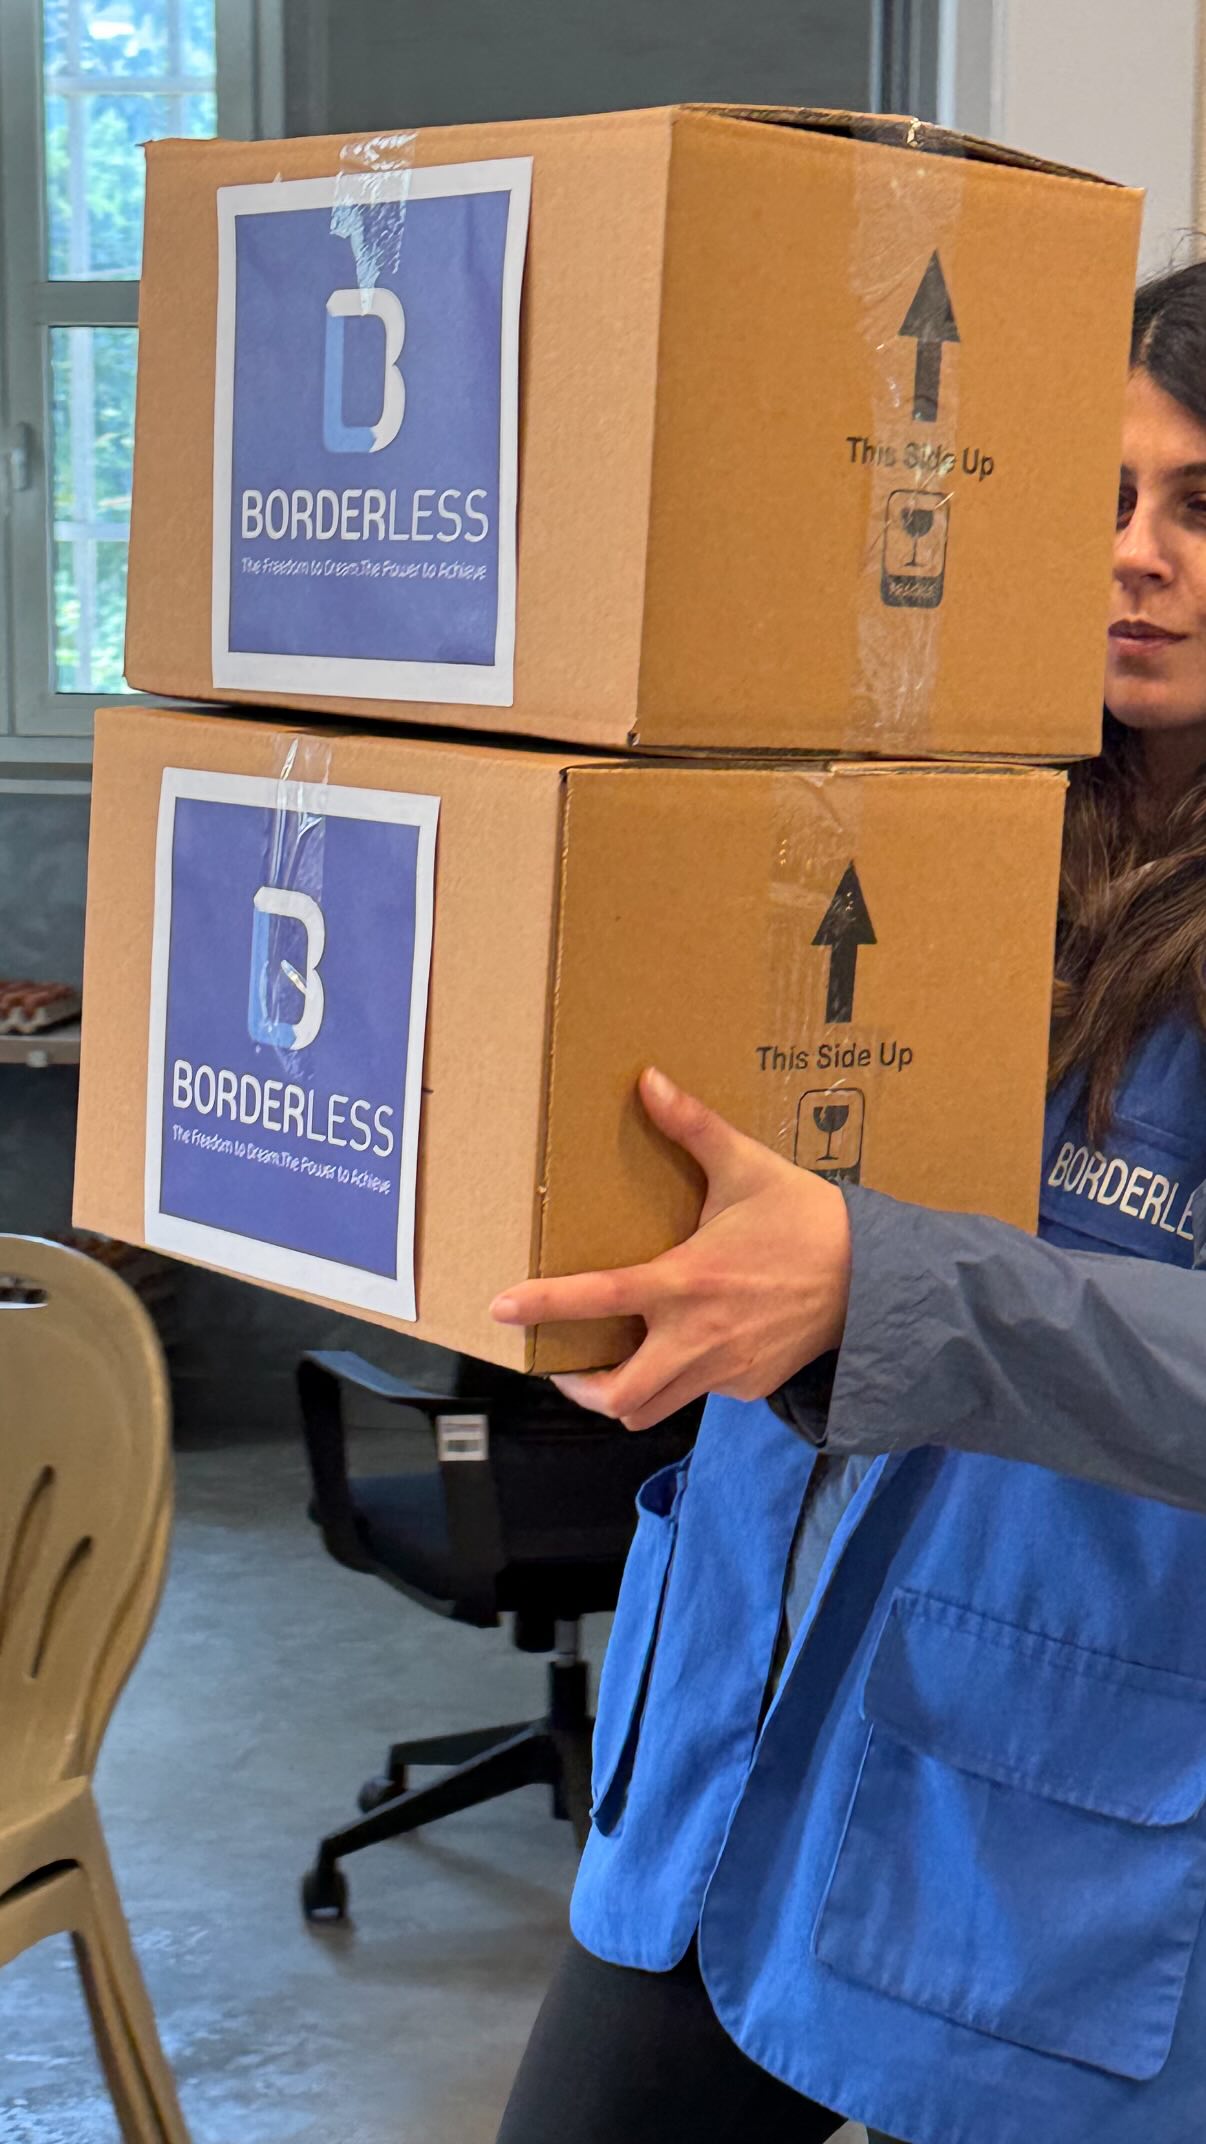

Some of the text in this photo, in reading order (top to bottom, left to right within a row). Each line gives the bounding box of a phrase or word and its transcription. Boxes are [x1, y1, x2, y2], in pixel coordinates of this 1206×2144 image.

[846, 436, 995, 482] This Side Up
[241, 487, 489, 544] BORDERLESS
[756, 1040, 913, 1072] This Side Up
[172, 1059, 395, 1158] BORDERLESS
[1047, 1141, 1195, 1241] BORDERLE
